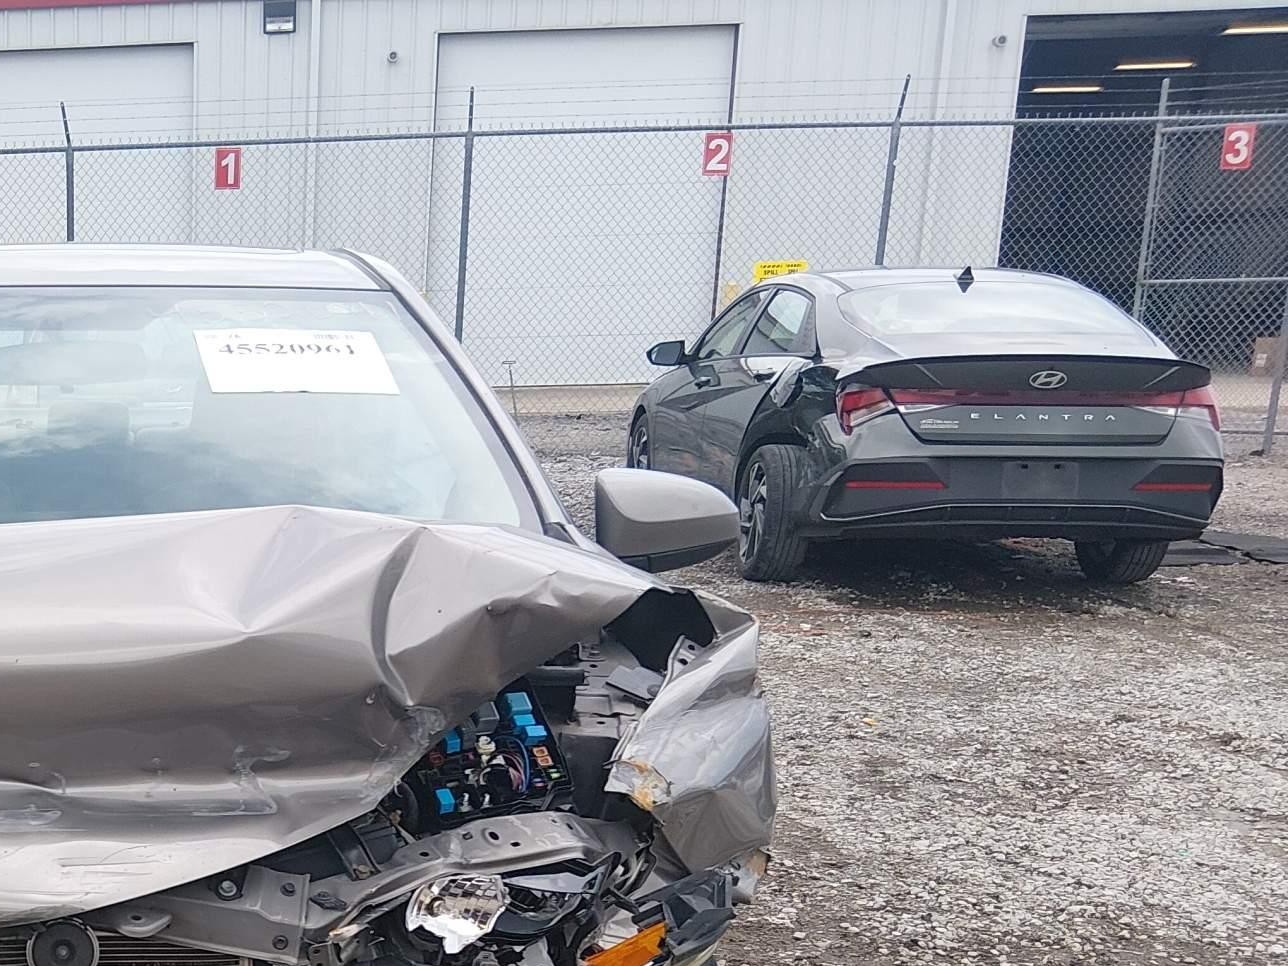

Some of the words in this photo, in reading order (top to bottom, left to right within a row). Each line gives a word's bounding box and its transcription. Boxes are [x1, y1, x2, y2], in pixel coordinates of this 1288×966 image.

[706, 138, 729, 171] 2
[1225, 130, 1249, 165] 3
[221, 152, 235, 185] 1
[970, 412, 1116, 421] ELANTRA
